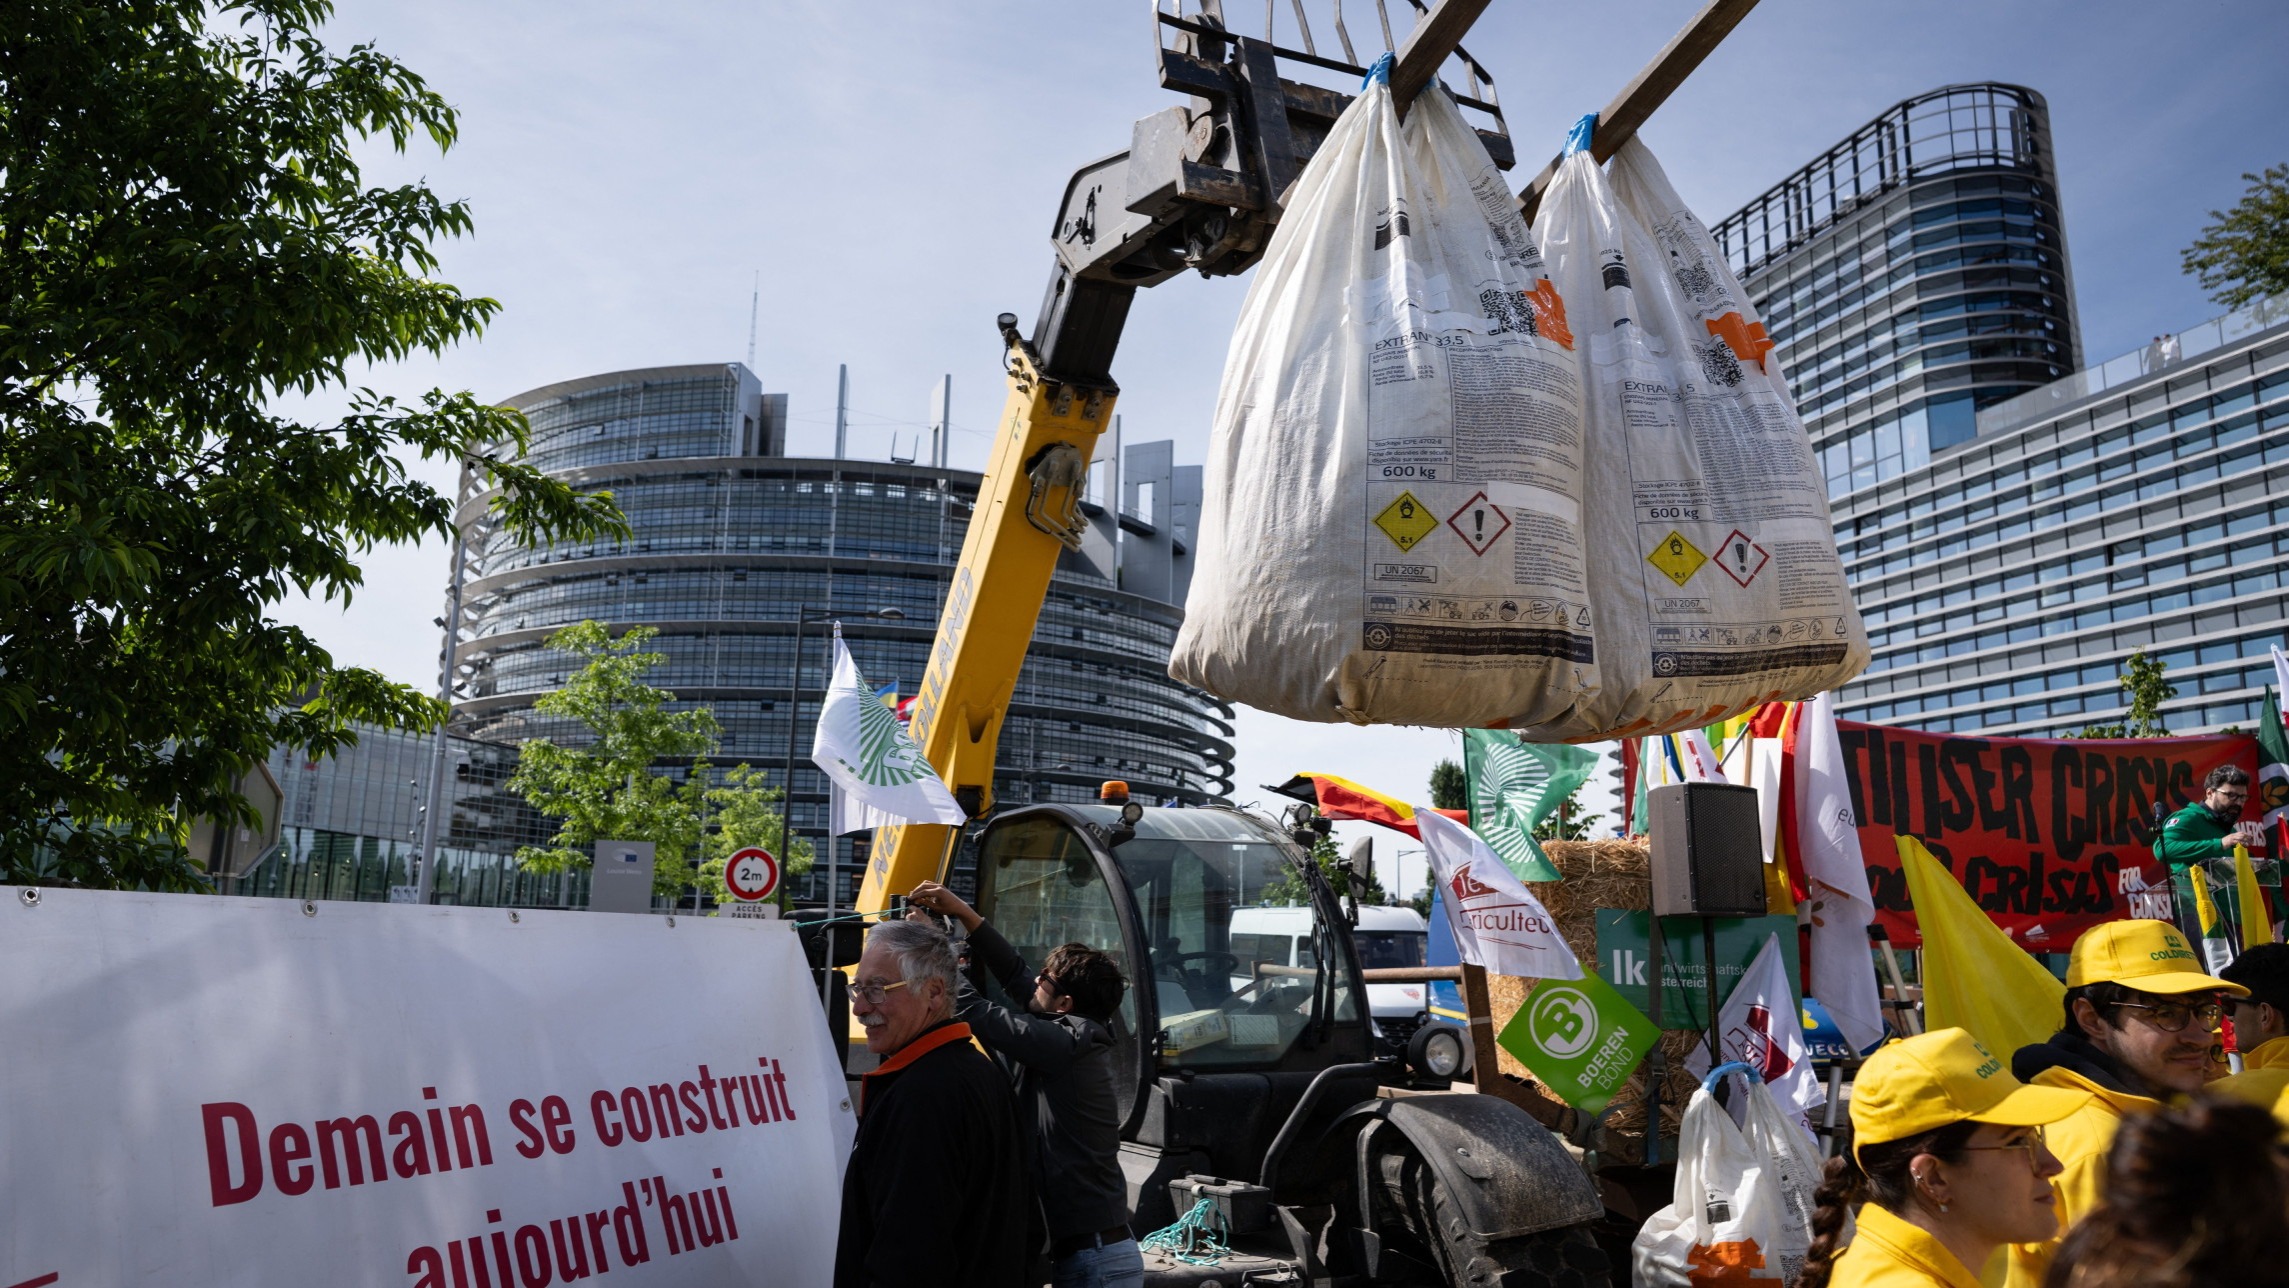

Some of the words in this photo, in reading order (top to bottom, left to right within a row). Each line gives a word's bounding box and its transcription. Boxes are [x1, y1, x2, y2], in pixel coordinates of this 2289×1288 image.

[1383, 466, 1415, 477] 600
[1420, 466, 1436, 480] kg
[1650, 507, 1680, 518] 600
[1684, 508, 1699, 519] kg
[1400, 536, 1413, 544] 5.1
[1385, 565, 1399, 574] UN
[1401, 566, 1425, 575] 2067
[1674, 571, 1686, 579] 5.1
[1679, 599, 1700, 607] 2067
[913, 565, 975, 753] OLLAND
[2052, 744, 2195, 862] CRISIS
[1837, 806, 1856, 829] eu
[740, 867, 762, 881] 2m
[1963, 851, 2120, 916] CRISIS
[2118, 866, 2149, 895] FOR
[731, 912, 766, 920] PARKING
[736, 903, 763, 912] ACCÈS
[1471, 909, 1554, 934] riculteu
[1576, 1025, 1630, 1089] BOEREN
[1596, 1046, 1634, 1090] BOND
[203, 1087, 493, 1207] Demain
[510, 1095, 575, 1159] se
[592, 1056, 796, 1148] construit
[408, 1167, 740, 1288] aujourd'hui
